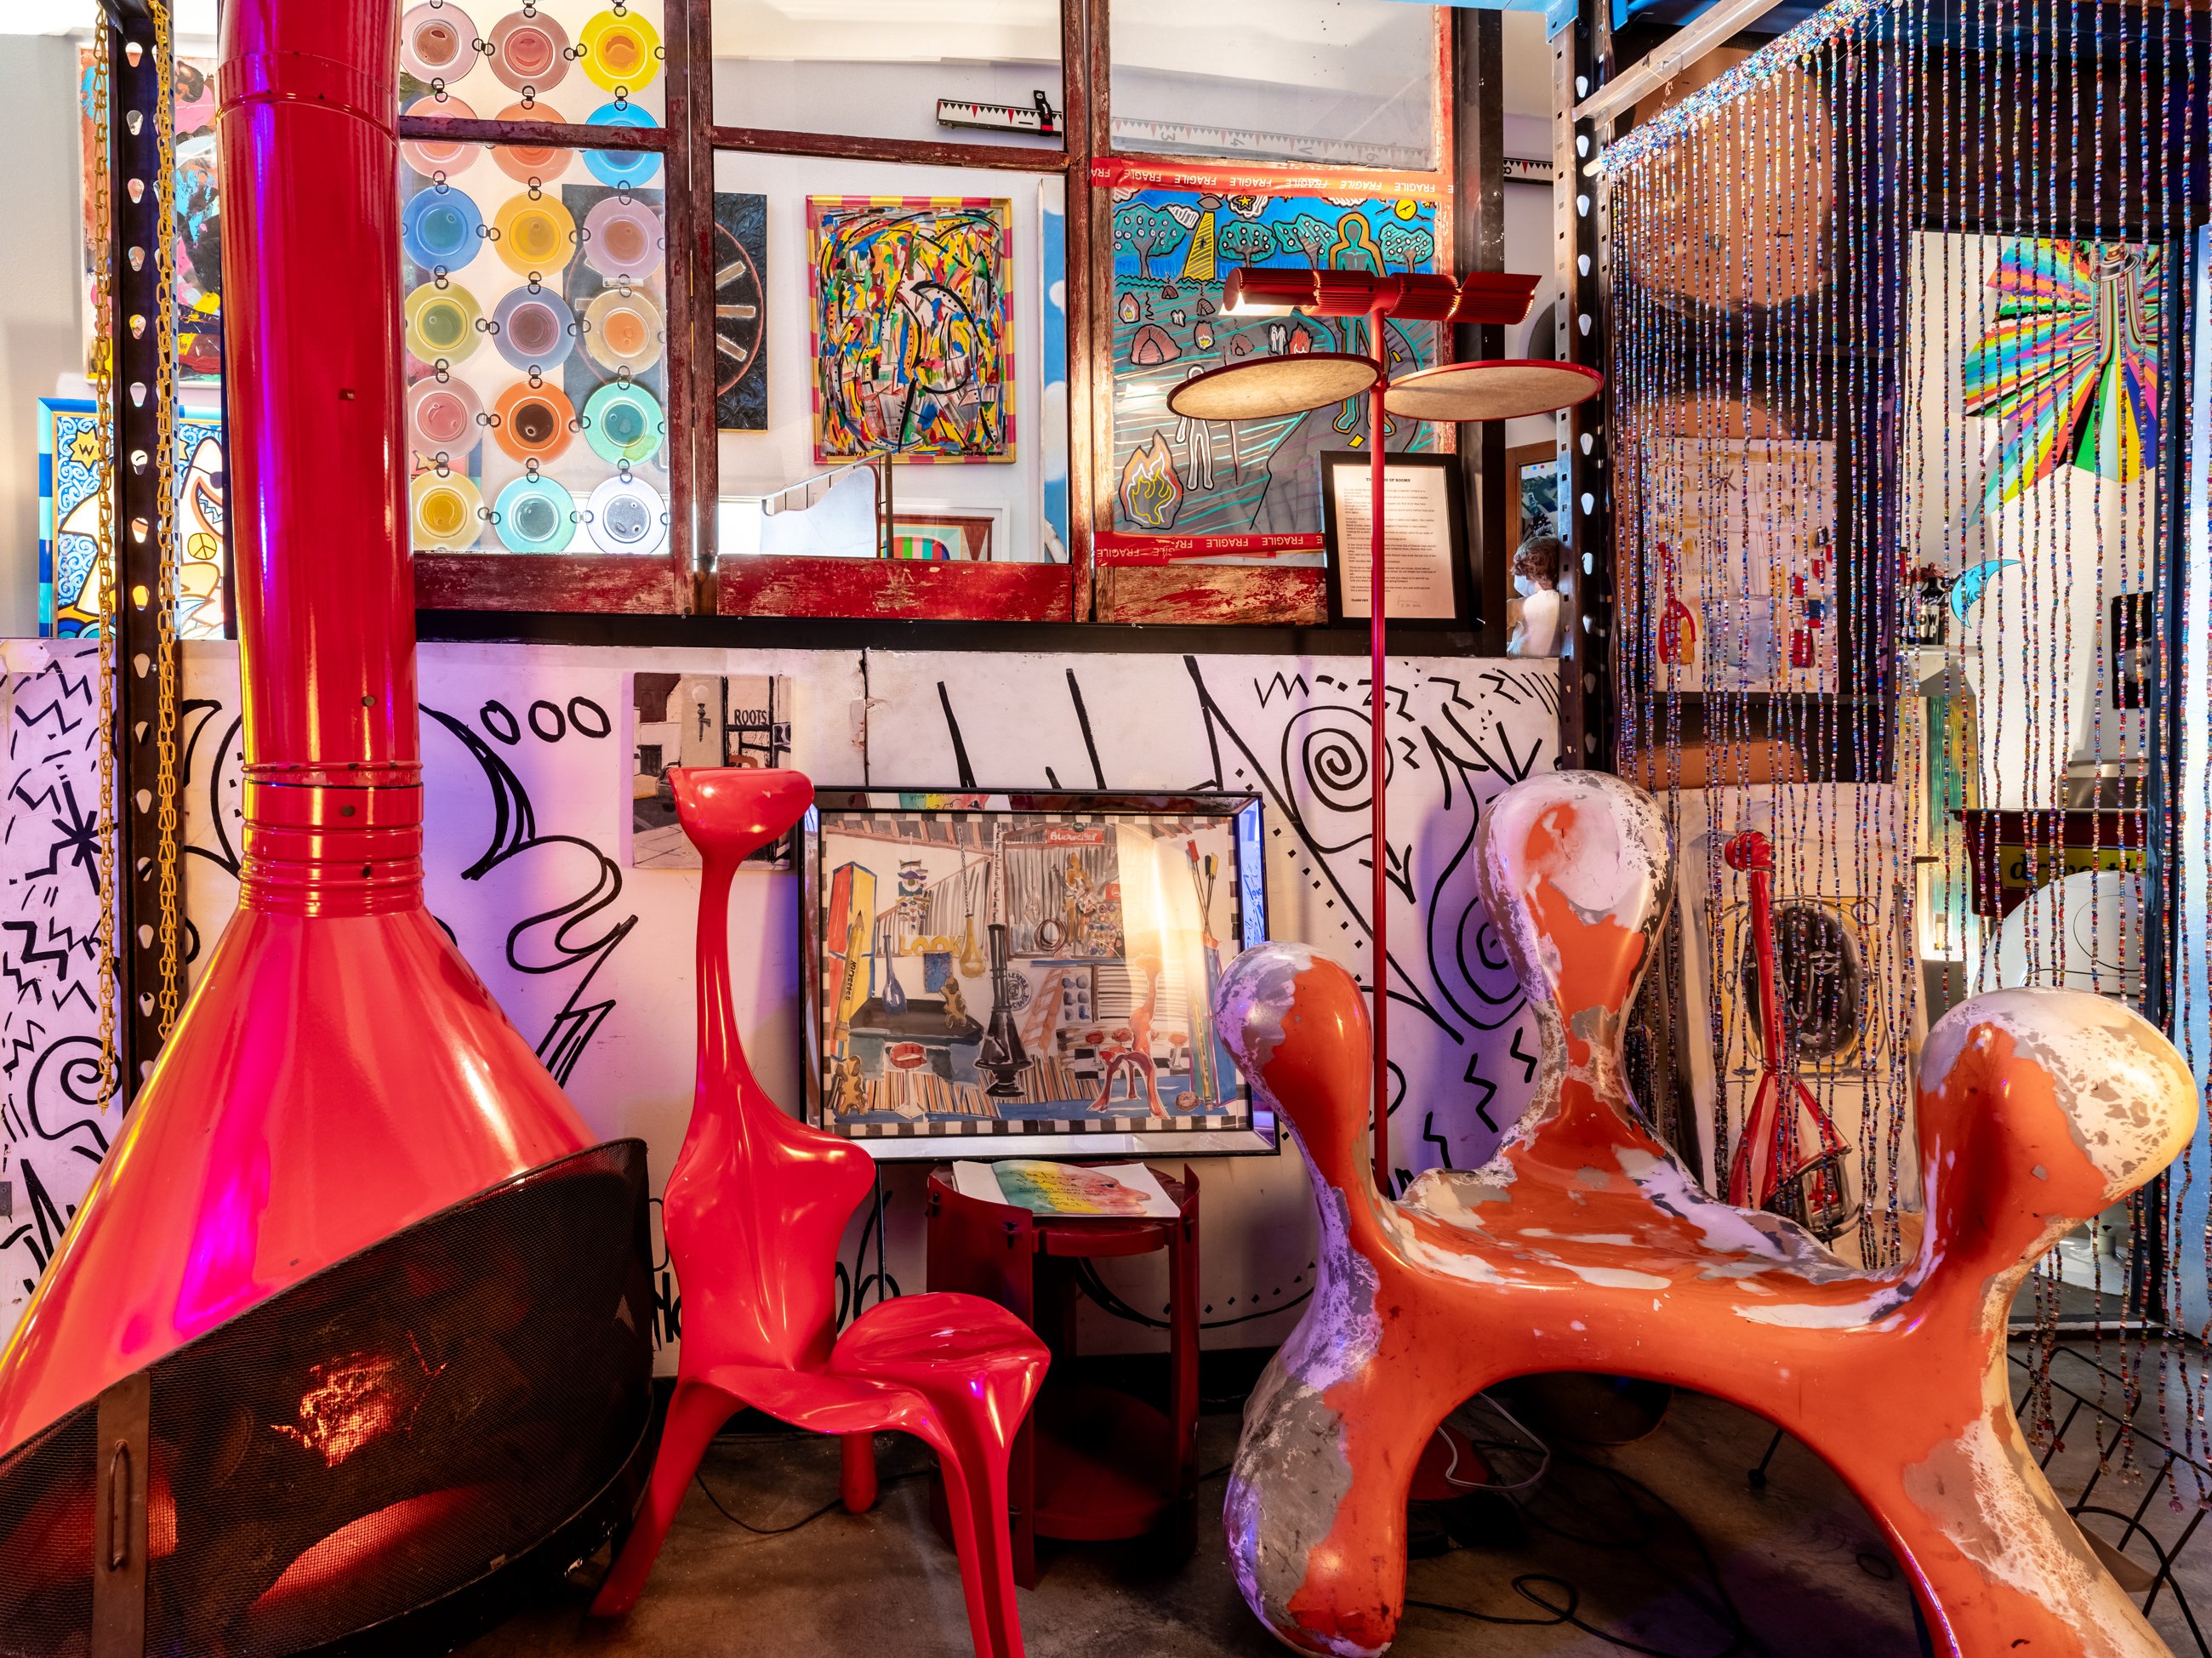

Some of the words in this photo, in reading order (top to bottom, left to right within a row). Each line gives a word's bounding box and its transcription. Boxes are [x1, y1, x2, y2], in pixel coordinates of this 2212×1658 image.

[1123, 168, 1161, 182] FRAGILE
[1174, 174, 1217, 185] FRAGILE
[1229, 176, 1272, 187] FRAGILE
[1339, 179, 1382, 191] FRAGILE
[1394, 181, 1436, 193] FRAGILE
[1206, 538, 1250, 549] FRAGILE
[1261, 536, 1304, 547] FRAGILE
[1096, 548, 1141, 558] FRAGILE
[733, 709, 768, 726] ROOTS
[900, 934, 966, 957] LOOK
